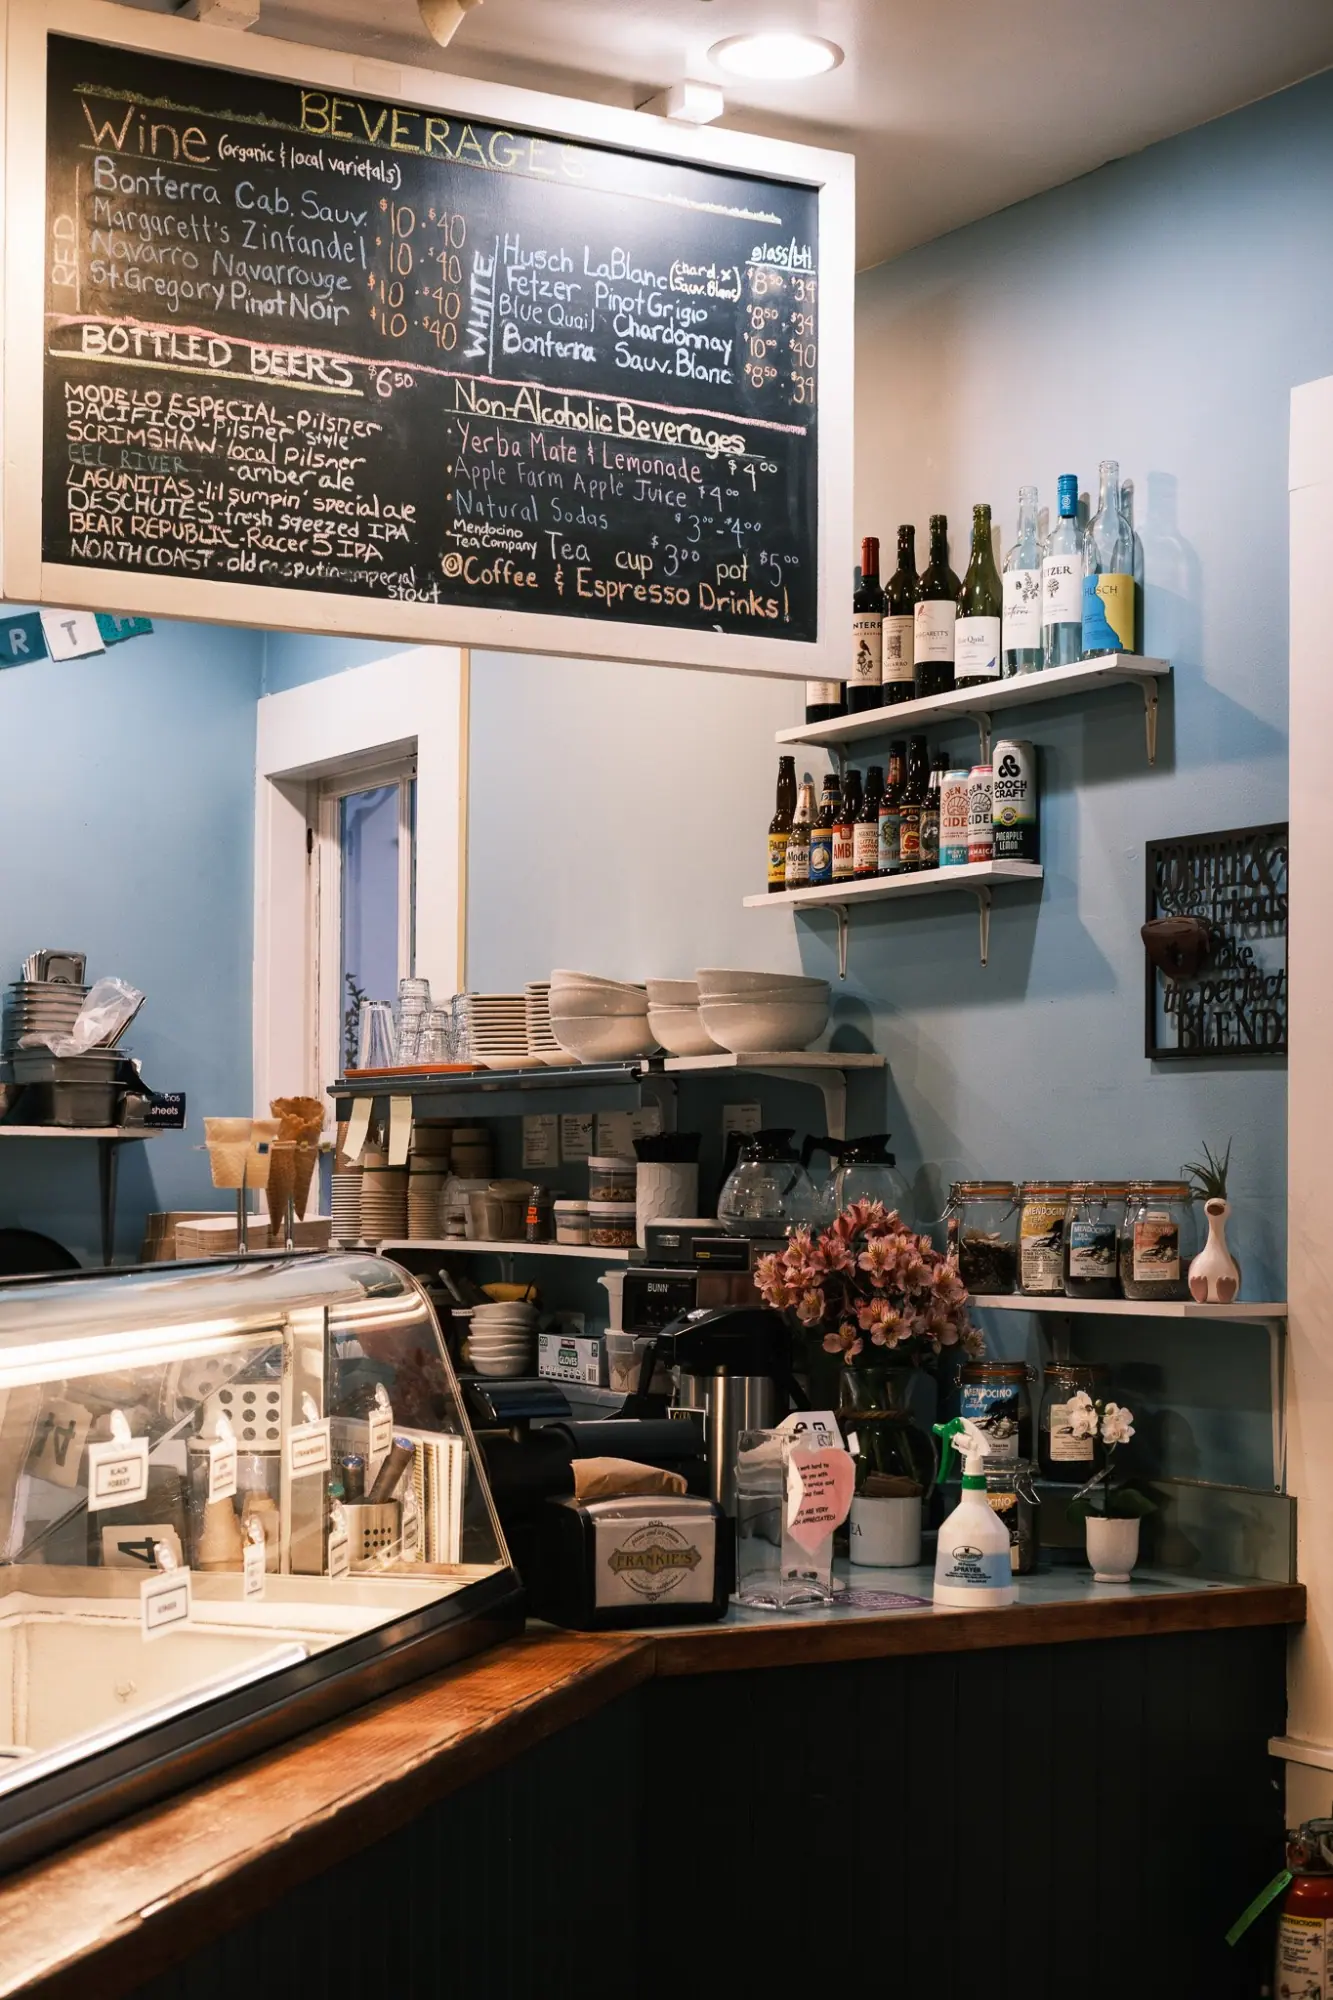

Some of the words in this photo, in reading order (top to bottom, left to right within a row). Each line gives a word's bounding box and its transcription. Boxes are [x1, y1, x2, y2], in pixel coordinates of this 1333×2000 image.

[81, 97, 210, 162] Wine
[291, 147, 324, 171] local
[300, 92, 584, 178] BEVERAGES
[94, 155, 221, 205] Bonterra
[235, 181, 294, 216] Cab.
[301, 190, 367, 227] Sauv.
[51, 213, 78, 288] RED
[93, 196, 230, 243] Margarett's
[242, 219, 367, 270] Zinfandel
[504, 232, 573, 274] Husch
[91, 228, 199, 270] Navarro
[212, 250, 351, 299] Navarrouge
[231, 280, 287, 317] Pinot
[290, 292, 350, 326] Noir
[463, 250, 495, 358] WHITE
[506, 265, 581, 303] Fetzer
[595, 281, 645, 316] Pinot
[647, 293, 708, 329] Grigio
[499, 293, 543, 325] Blue
[547, 303, 595, 333] Quail
[612, 314, 732, 365] Chardonnay
[82, 323, 233, 368] BOTTLED
[250, 348, 354, 388] BEERS
[502, 322, 597, 363] Bonterra
[614, 341, 672, 375] Sauv.
[675, 349, 735, 385] Blanc
[65, 382, 162, 408] MODELO
[169, 393, 286, 428] ESPECIAL
[67, 400, 196, 432] PACIFICO
[454, 378, 613, 432] Non-Alcoholic
[616, 403, 747, 460] Beverages
[67, 420, 217, 454] SCRIMSHAW
[457, 419, 522, 458] Yerba
[530, 432, 577, 463] Mate
[602, 441, 703, 484] Lemonade
[66, 464, 195, 500] LAGUNITAS
[313, 493, 380, 519] special
[120, 449, 190, 473] RIVER
[318, 468, 355, 492] ale
[454, 456, 507, 491] Apple
[517, 462, 564, 490] Farm
[574, 472, 624, 501] Apple
[633, 479, 687, 508] Juice
[68, 488, 215, 525] DESCHUTES
[368, 522, 410, 543] IPA
[455, 489, 539, 523] Natural
[550, 497, 609, 530] Sodas
[69, 512, 125, 538] BEAR
[131, 515, 239, 549] REPUBLIC
[311, 533, 333, 556] 5
[337, 540, 384, 563] IPA
[70, 535, 142, 564] NORTH
[145, 545, 215, 571] COAST
[451, 533, 480, 549] Tea
[481, 534, 538, 561] Company
[453, 519, 524, 538] Mendocino
[545, 530, 591, 562] Tea
[615, 551, 653, 580] cup
[716, 551, 749, 586] pot
[387, 581, 442, 604] stout
[576, 566, 691, 608] Espresso
[698, 582, 790, 623] Drinks!
[1085, 584, 1119, 597] HUSCH
[9, 628, 30, 655] R
[60, 619, 77, 646] T
[995, 780, 1027, 790] BOOCH
[995, 789, 1025, 799] CRAFT
[1176, 1005, 1283, 1049] BLEND
[647, 1282, 668, 1293] BUNN
[964, 1387, 1013, 1399] MENDOCINO
[110, 1466, 128, 1476] BLACK
[611, 1551, 693, 1568] FRANKIE'S
[953, 1565, 982, 1573] SPRAYER
